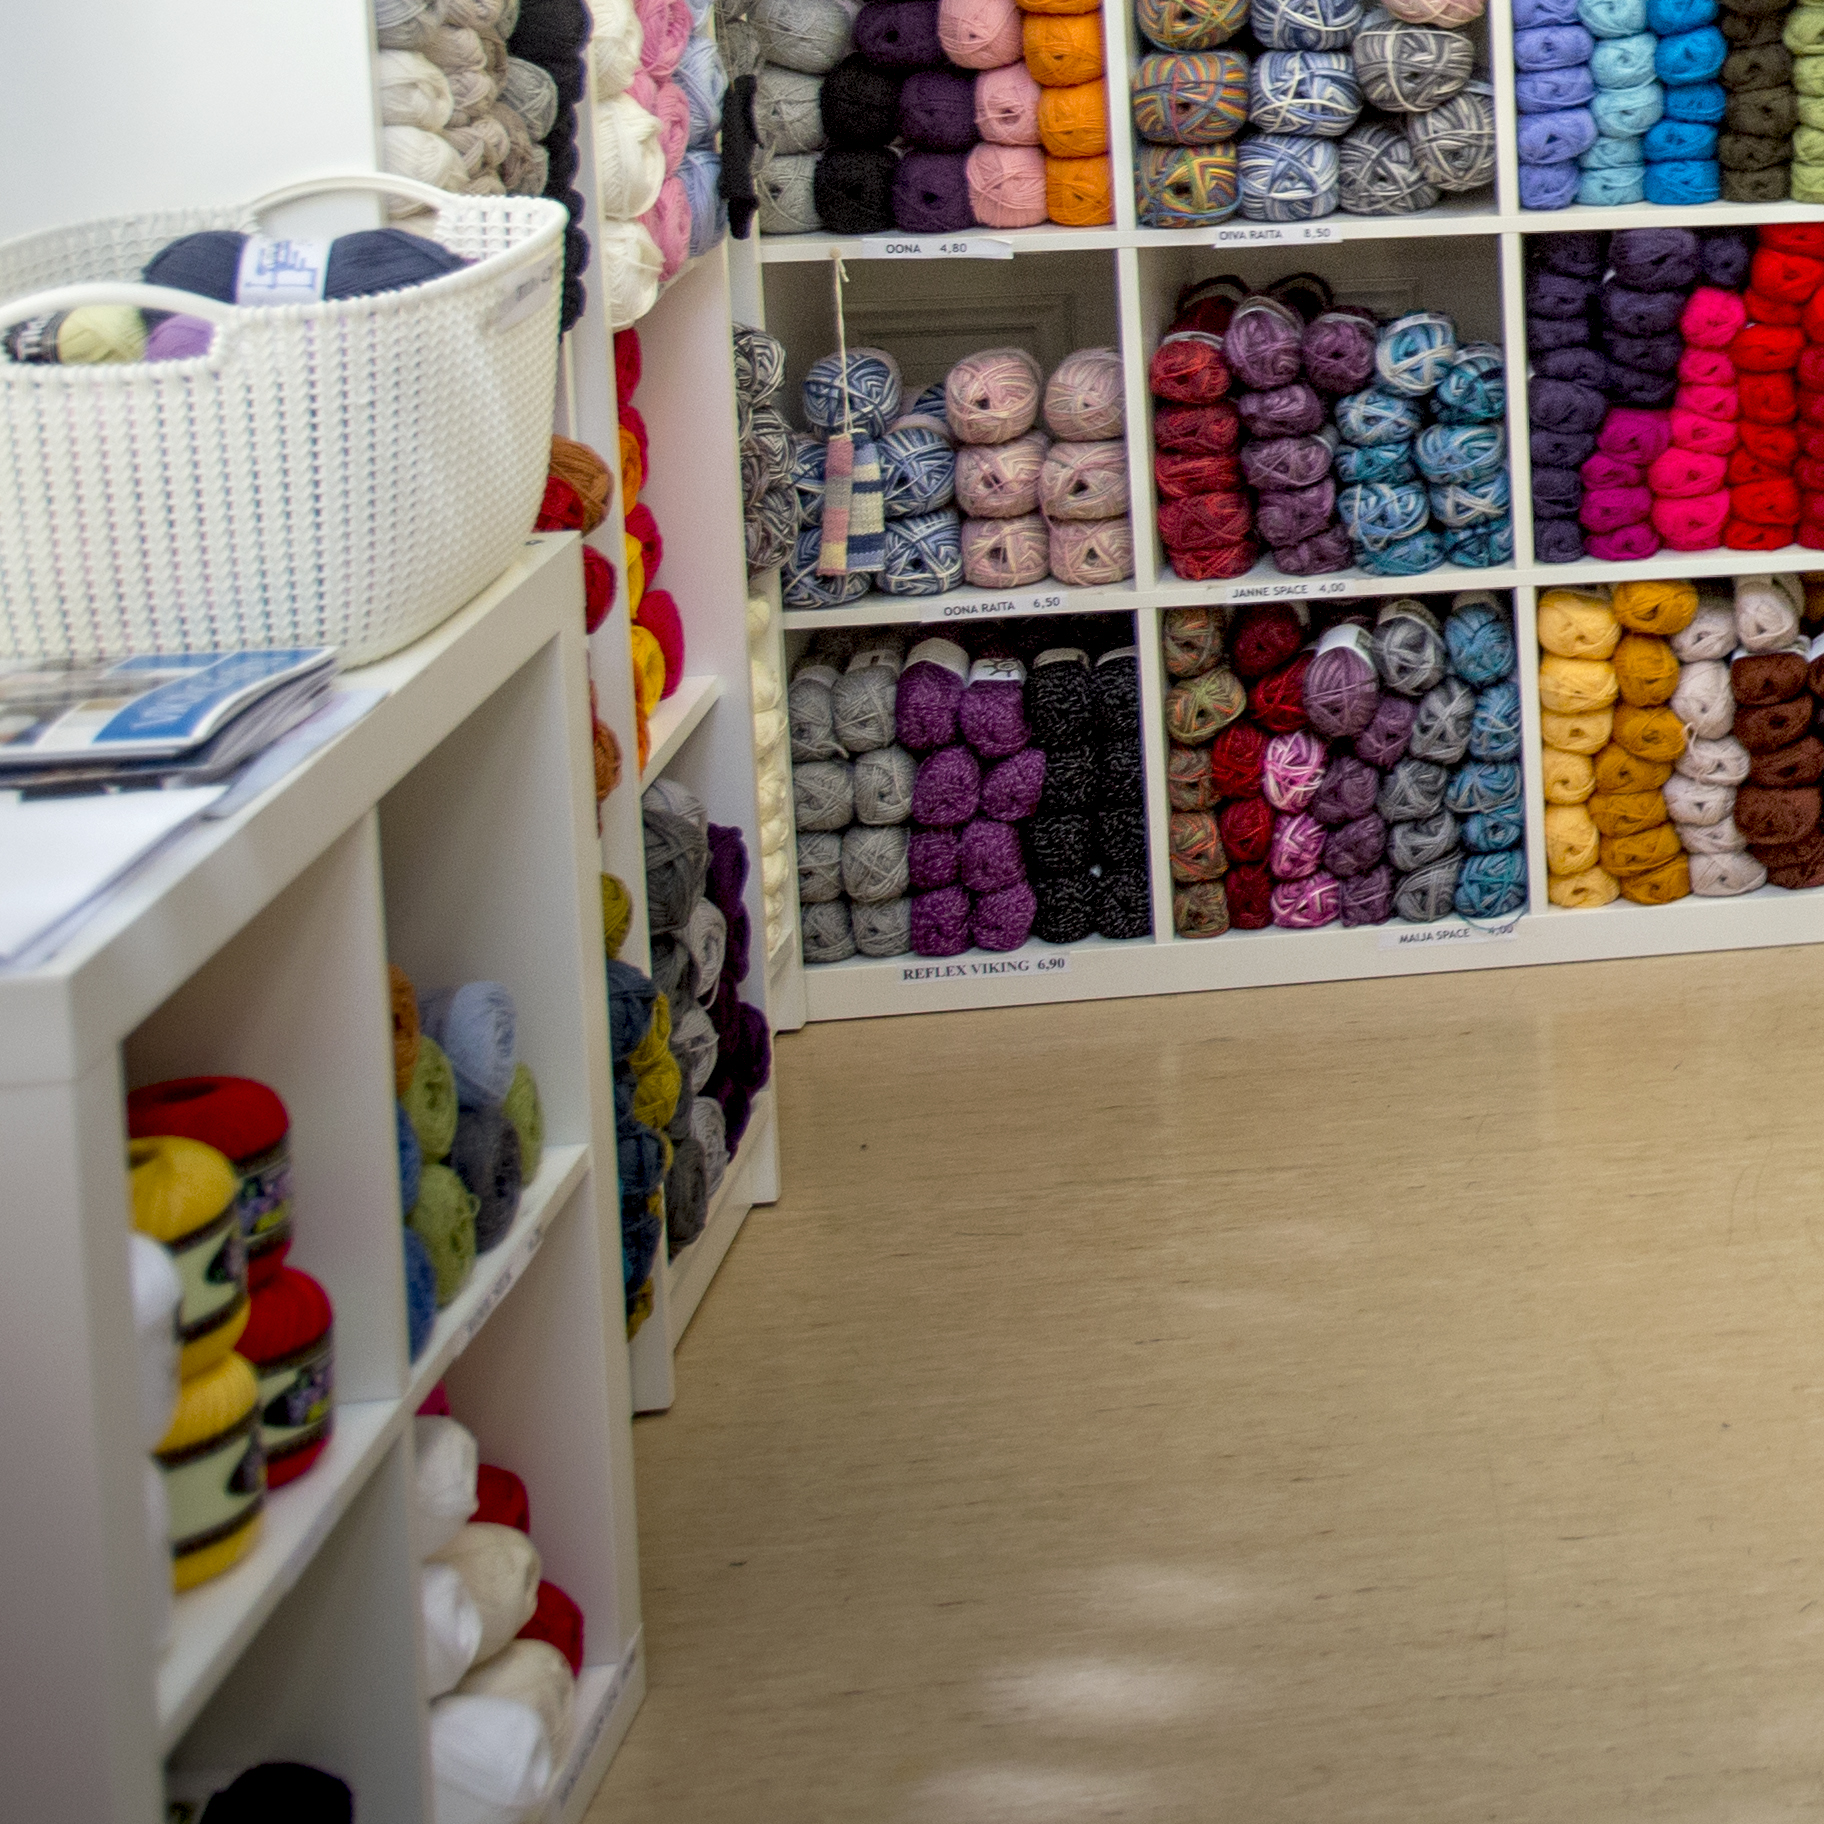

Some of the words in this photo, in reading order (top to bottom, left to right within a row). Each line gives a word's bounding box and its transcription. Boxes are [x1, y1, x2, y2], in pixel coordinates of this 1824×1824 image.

[1249, 228, 1283, 239] RAITA
[886, 243, 921, 254] OONA
[939, 243, 968, 254] 4,80
[1232, 587, 1270, 598] JANNE
[1273, 585, 1308, 596] SPACE
[943, 605, 979, 616] OONA
[981, 601, 1016, 613] RAITA
[1033, 597, 1060, 609] 6,50
[1399, 933, 1434, 944] MAIJA
[1435, 928, 1470, 940] SPACE
[903, 965, 967, 981] REFLEX
[971, 960, 1029, 975] VIKING
[1037, 958, 1065, 971] 6,90
